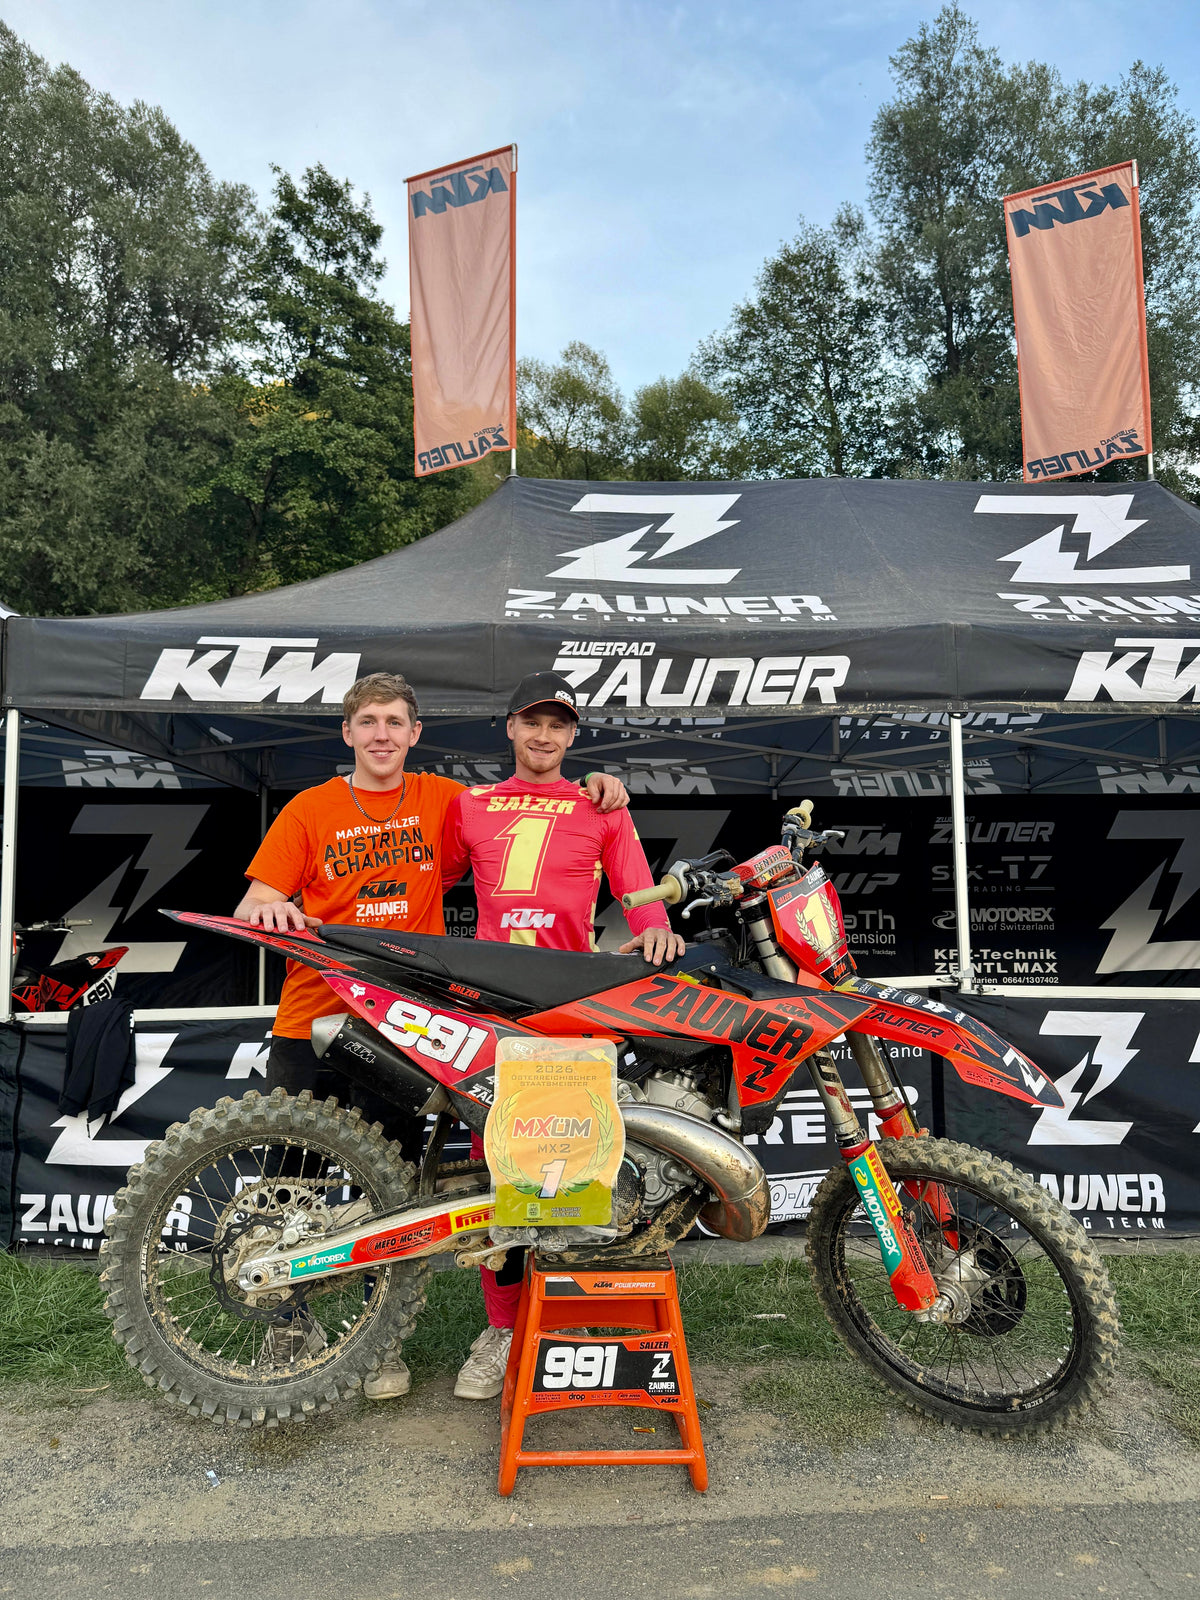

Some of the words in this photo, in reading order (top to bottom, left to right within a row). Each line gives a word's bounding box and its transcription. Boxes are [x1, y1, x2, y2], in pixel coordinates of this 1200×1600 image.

[504, 588, 833, 616] ZAUNER
[557, 641, 656, 657] ZWEIRAD
[139, 636, 362, 704] KTM
[1063, 638, 1200, 702] KT
[551, 655, 851, 707] ZAUNER
[486, 795, 577, 815] SALZER
[336, 825, 381, 840] MARVIN
[324, 827, 424, 862] AUSTRIAN
[333, 844, 434, 877] CHAMPION
[491, 813, 557, 897] 1
[357, 879, 408, 899] KTM
[356, 900, 408, 917] ZAUNER
[500, 908, 556, 929] KTM
[970, 907, 1054, 922] MOTOREX
[1000, 923, 1055, 931] Switzerland
[1014, 963, 1058, 974] MAX
[448, 983, 480, 1000] SALZER
[631, 977, 814, 1060] ZAUNER
[377, 1000, 489, 1073] 991
[343, 1041, 376, 1063] KTM
[536, 1065, 573, 1073] 2026
[538, 1158, 568, 1199] 1
[862, 1188, 899, 1256] MOTOREX
[1106, 1217, 1166, 1229] TEAM
[639, 1341, 669, 1350] SALZER
[542, 1345, 618, 1389] 991
[648, 1382, 675, 1390] ZAUNER
[568, 1393, 585, 1401] drop
